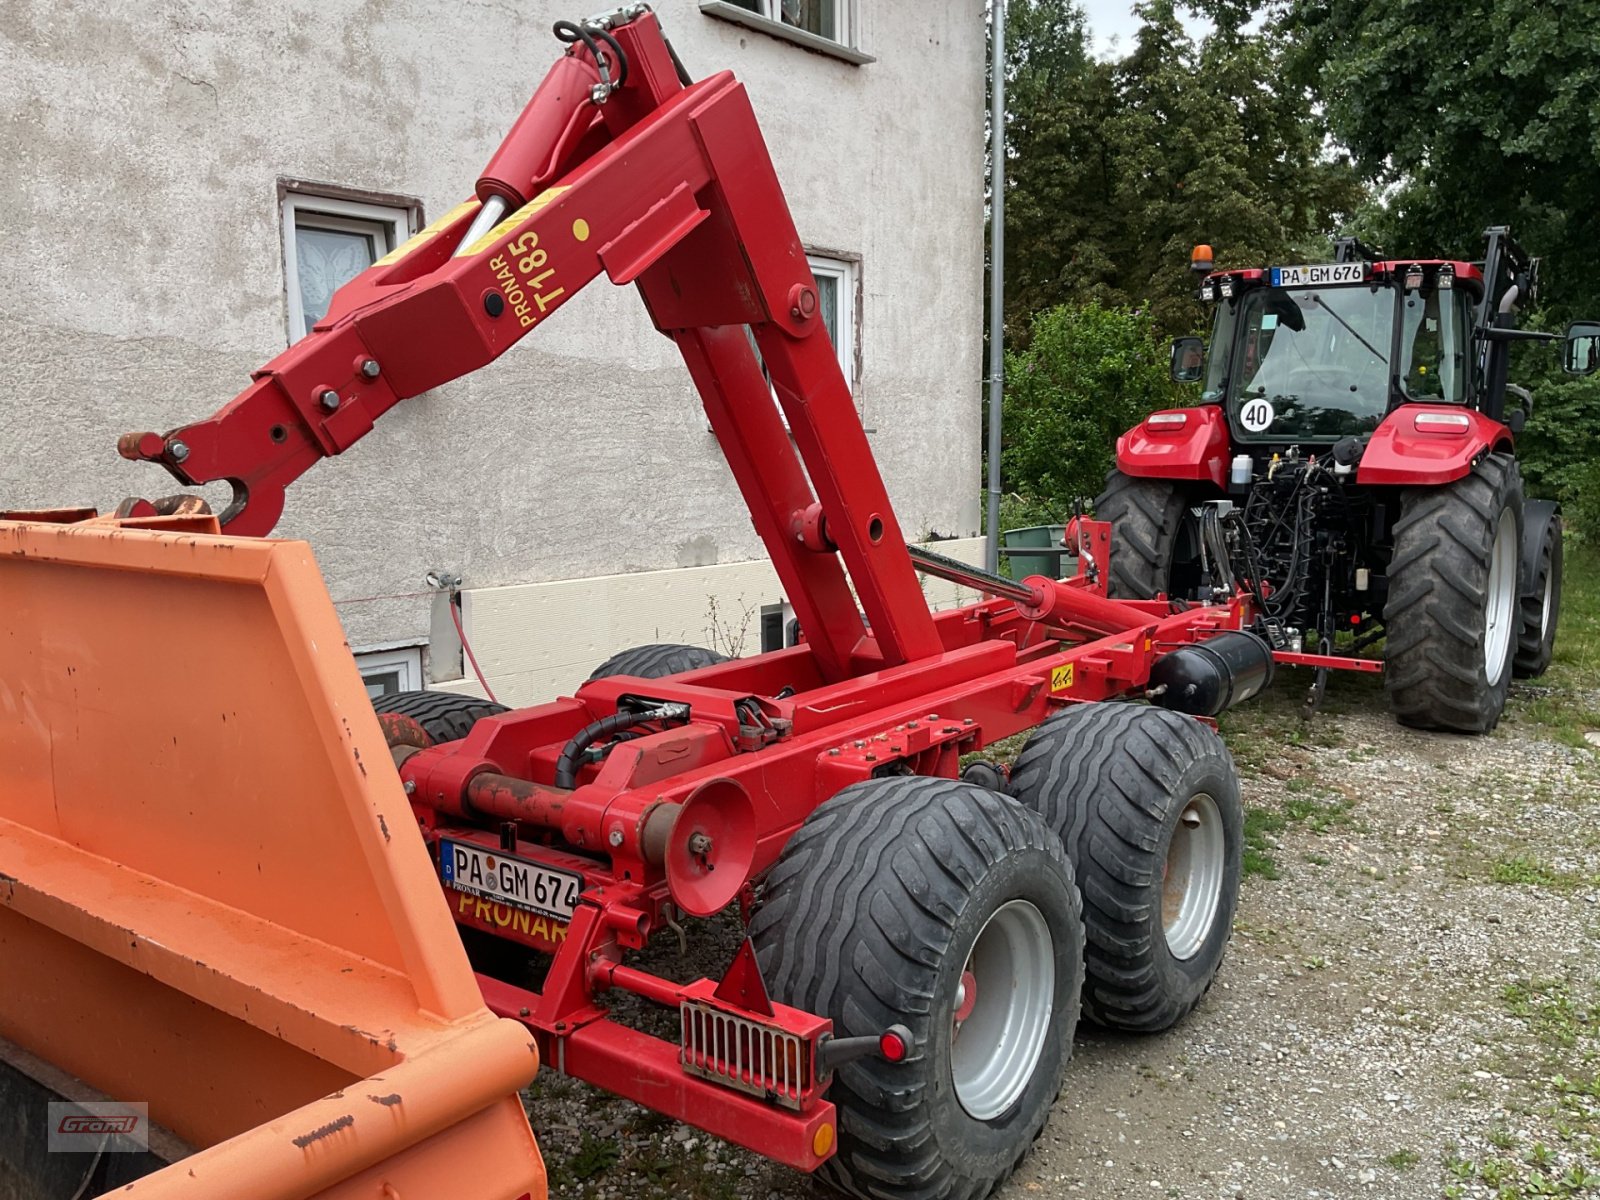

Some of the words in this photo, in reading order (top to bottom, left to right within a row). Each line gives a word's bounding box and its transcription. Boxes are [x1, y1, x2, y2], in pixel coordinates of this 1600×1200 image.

[489, 254, 537, 327] PRONAR
[507, 231, 565, 313] T185
[1281, 269, 1300, 284] PA
[1310, 267, 1330, 282] GM
[1333, 266, 1361, 281] 676
[1245, 404, 1267, 426] 40
[453, 883, 481, 898] PRONAR
[455, 848, 483, 885] PA
[499, 862, 529, 900] GM
[534, 872, 576, 908] 674
[459, 892, 569, 943] PRONAR
